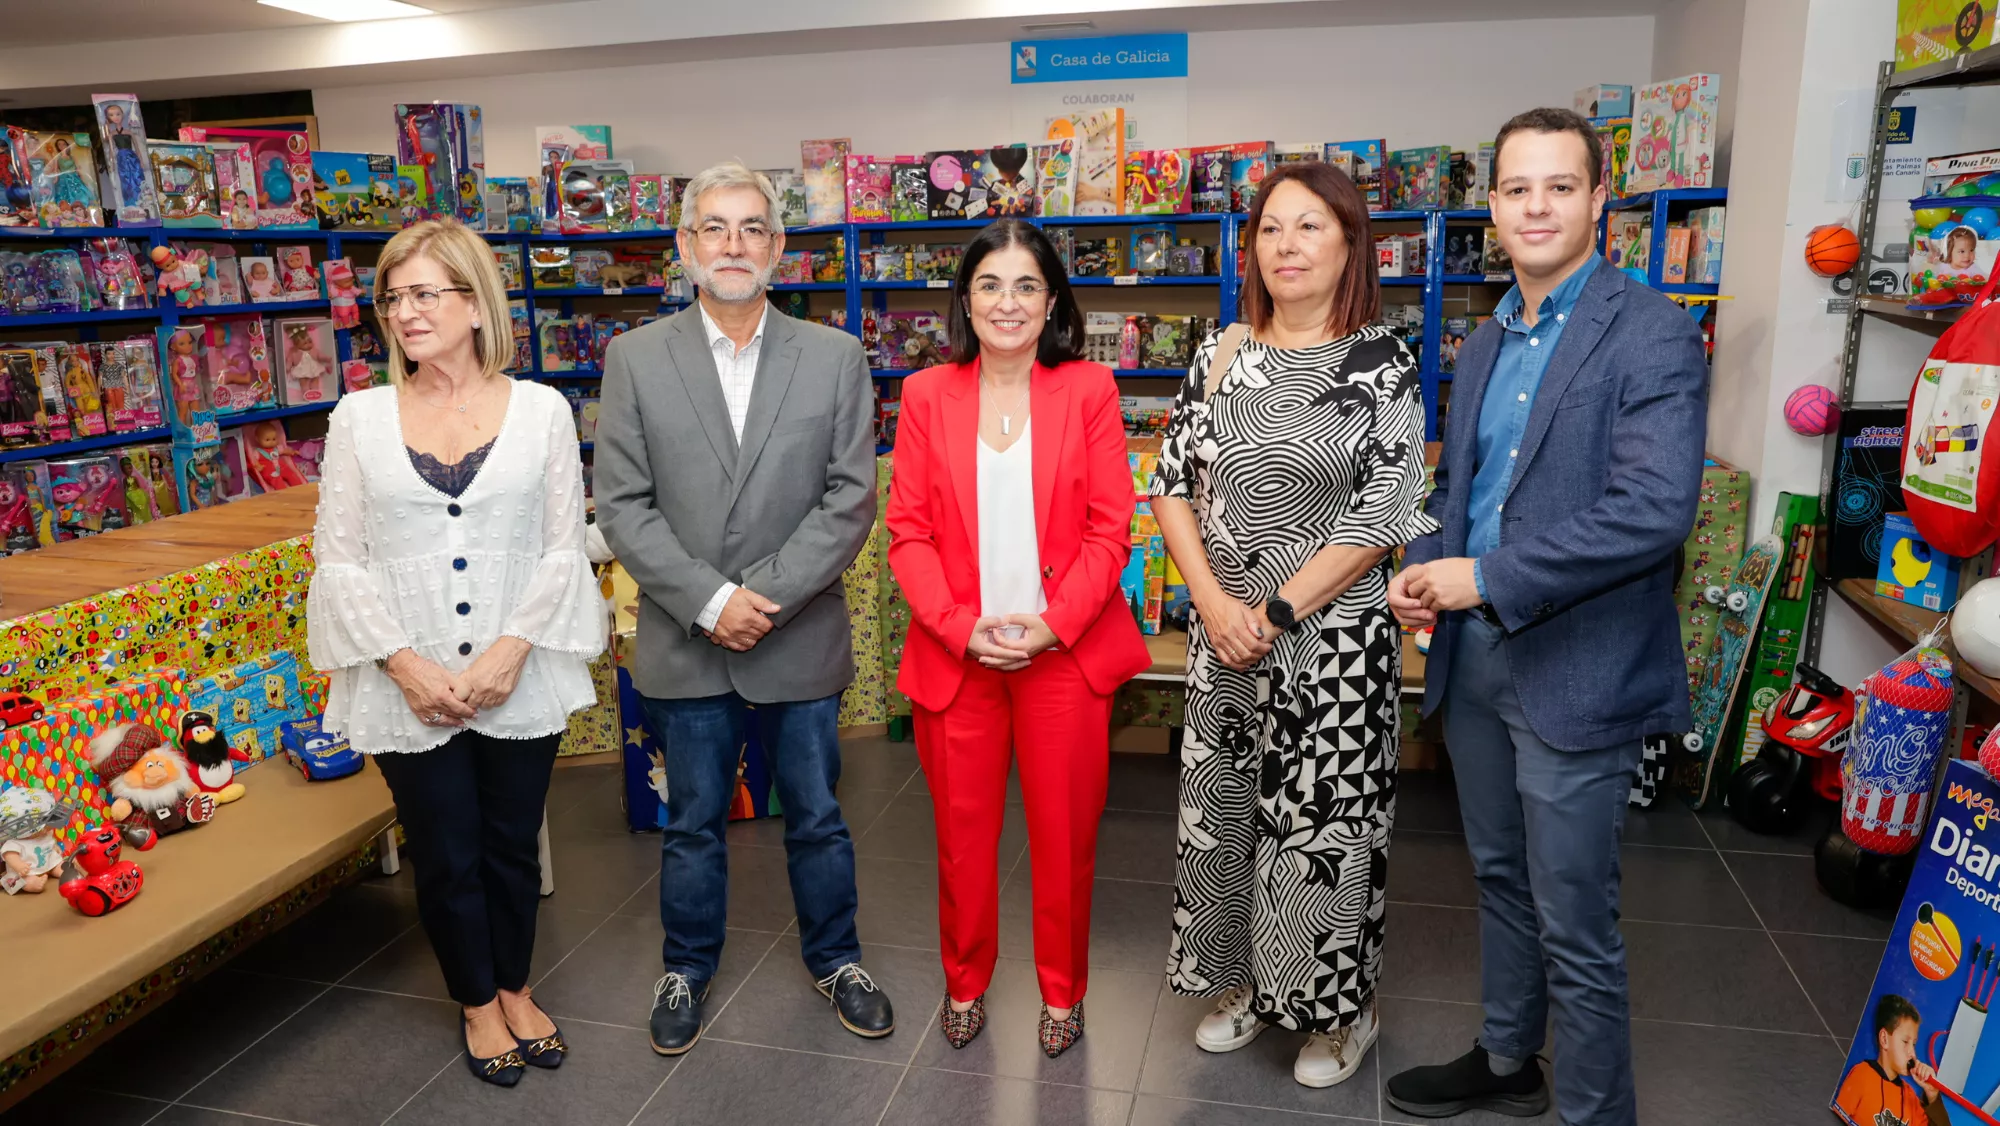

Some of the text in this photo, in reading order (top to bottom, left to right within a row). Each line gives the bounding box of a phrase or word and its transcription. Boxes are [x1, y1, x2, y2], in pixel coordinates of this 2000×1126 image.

[1050, 48, 1170, 67] Casa de Galicia
[1062, 92, 1135, 106] COLABORAN
[1980, 156, 2000, 166] PO
[47, 415, 68, 426] Barbie
[83, 414, 105, 426] Barbie
[114, 410, 135, 420] Barbie
[2, 424, 26, 435] Barbie
[1854, 435, 1903, 447] fighter
[1855, 771, 1923, 797] ATCH
